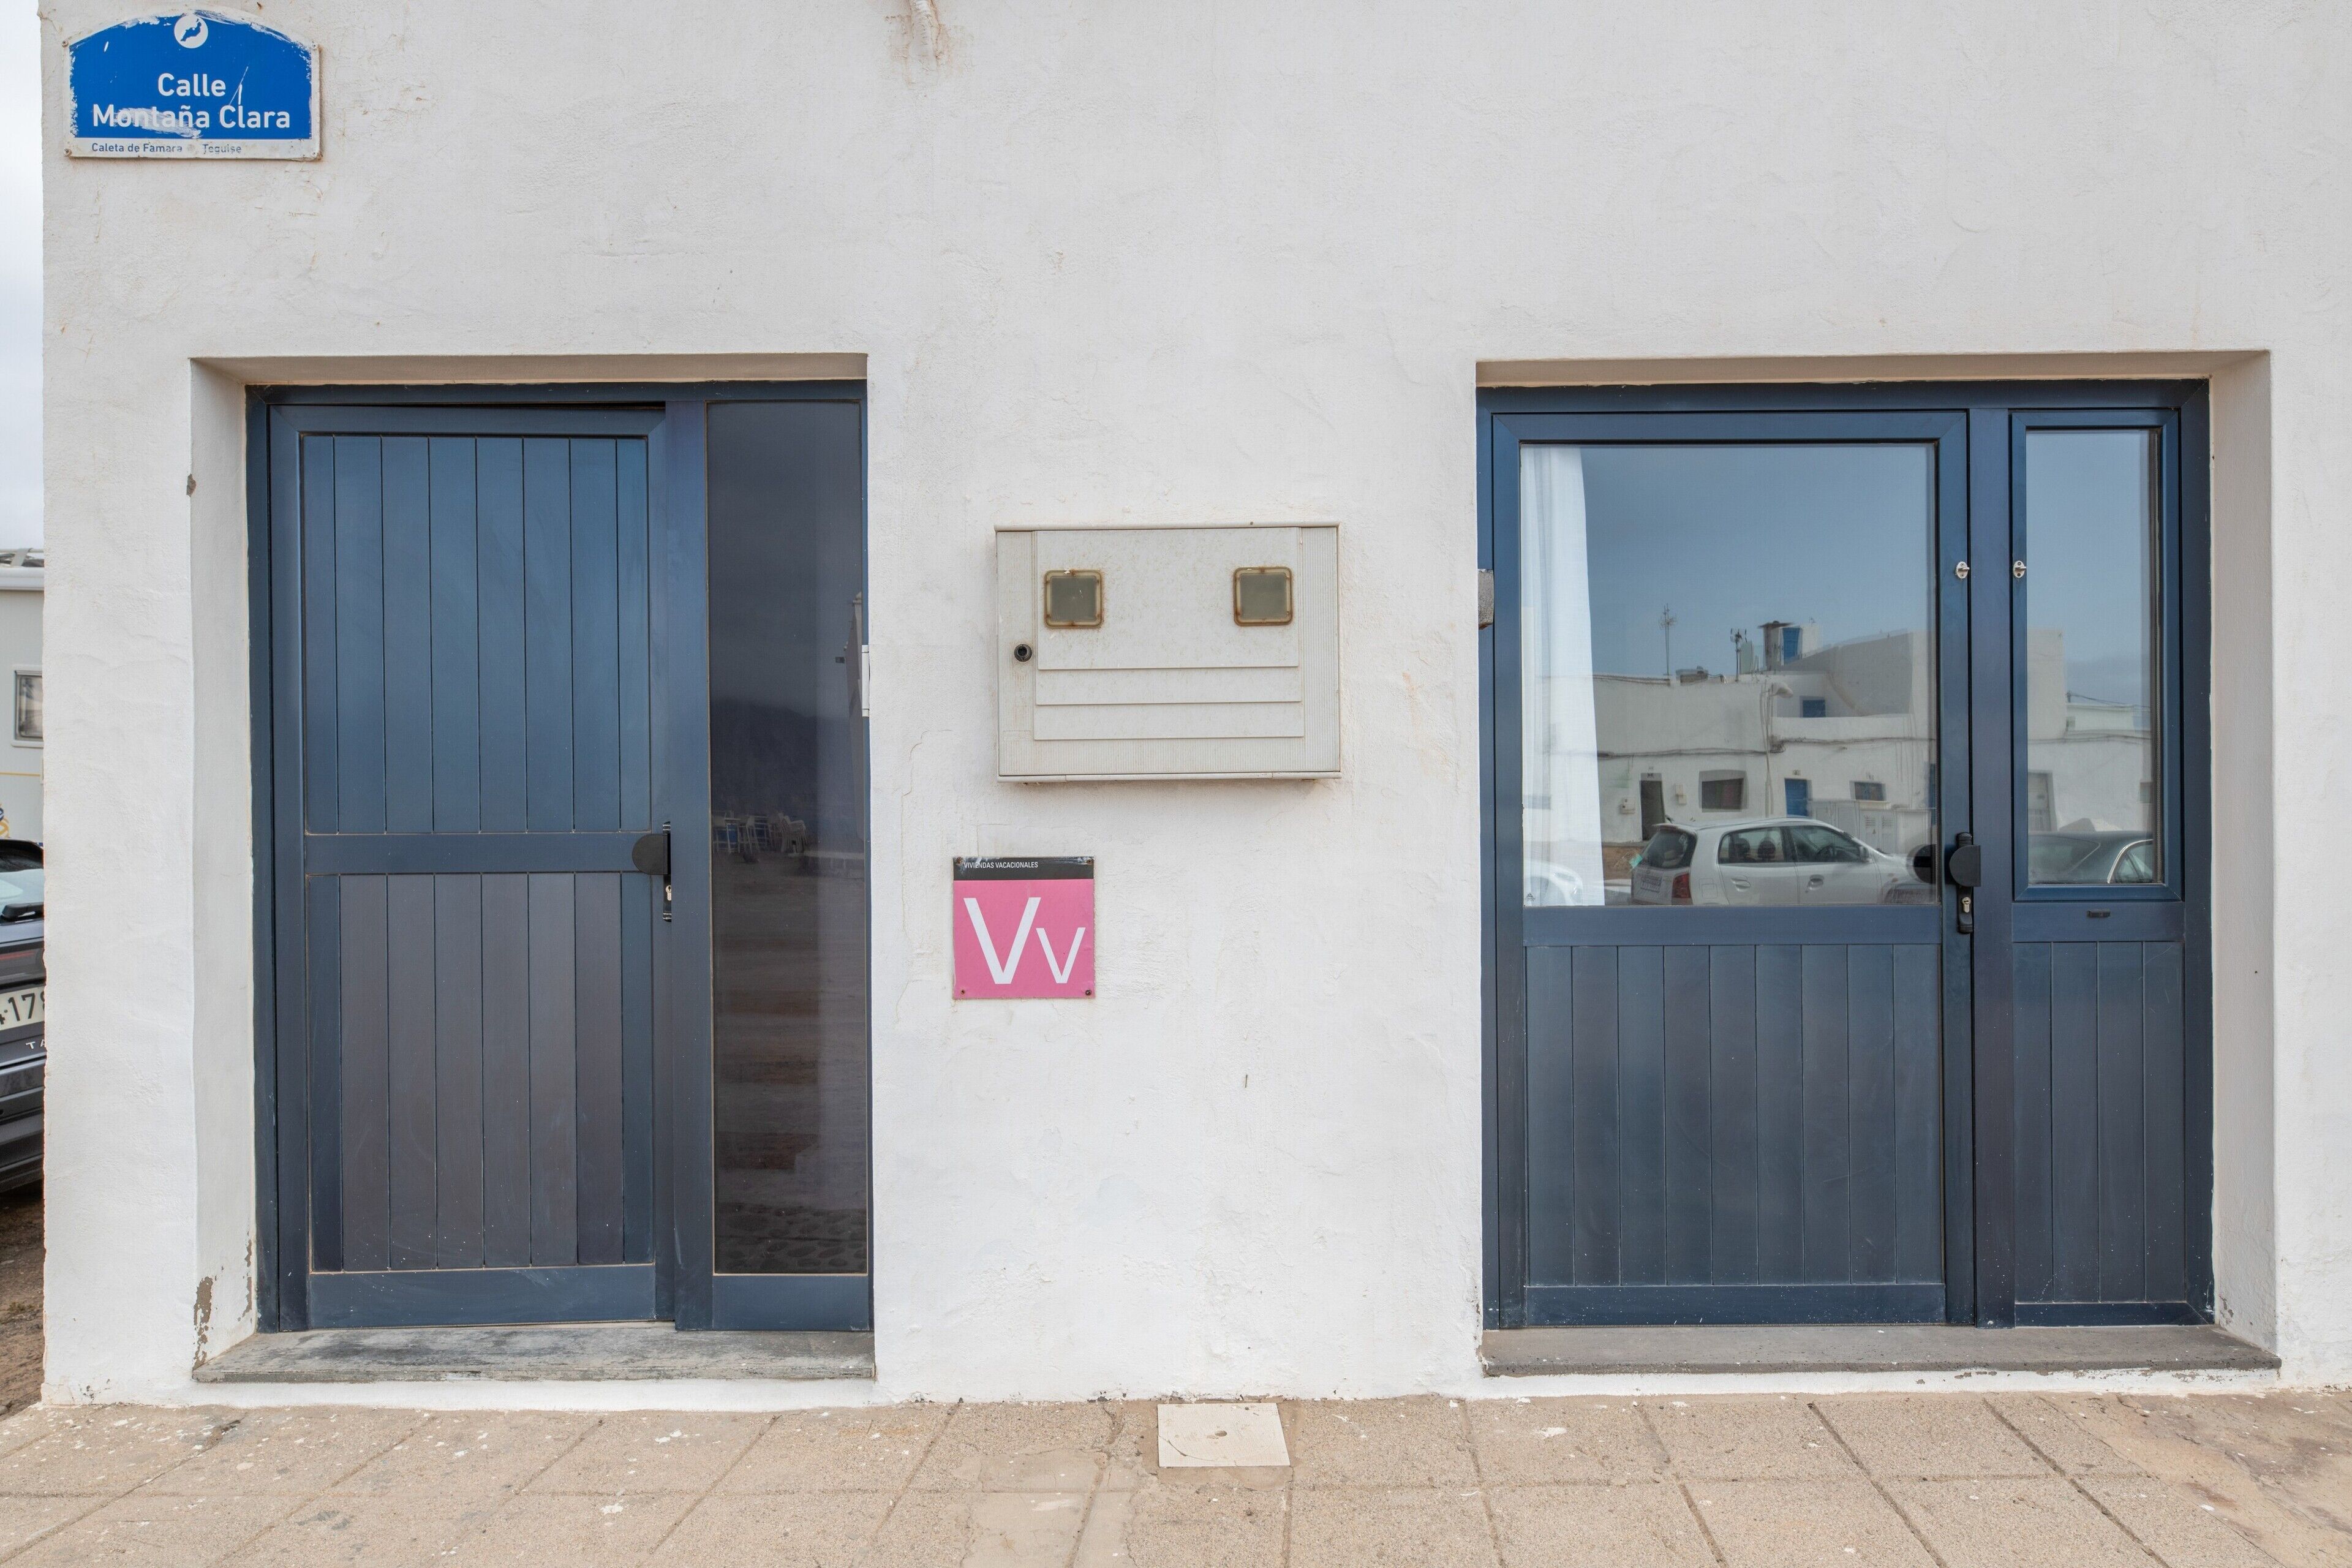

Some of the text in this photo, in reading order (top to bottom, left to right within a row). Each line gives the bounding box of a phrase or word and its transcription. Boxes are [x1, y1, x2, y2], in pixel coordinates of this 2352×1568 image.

[158, 73, 226, 97] Calle
[92, 104, 290, 129] Montaña Clara
[92, 143, 124, 152] Caleta
[127, 143, 140, 153] de
[143, 143, 183, 153] Famara
